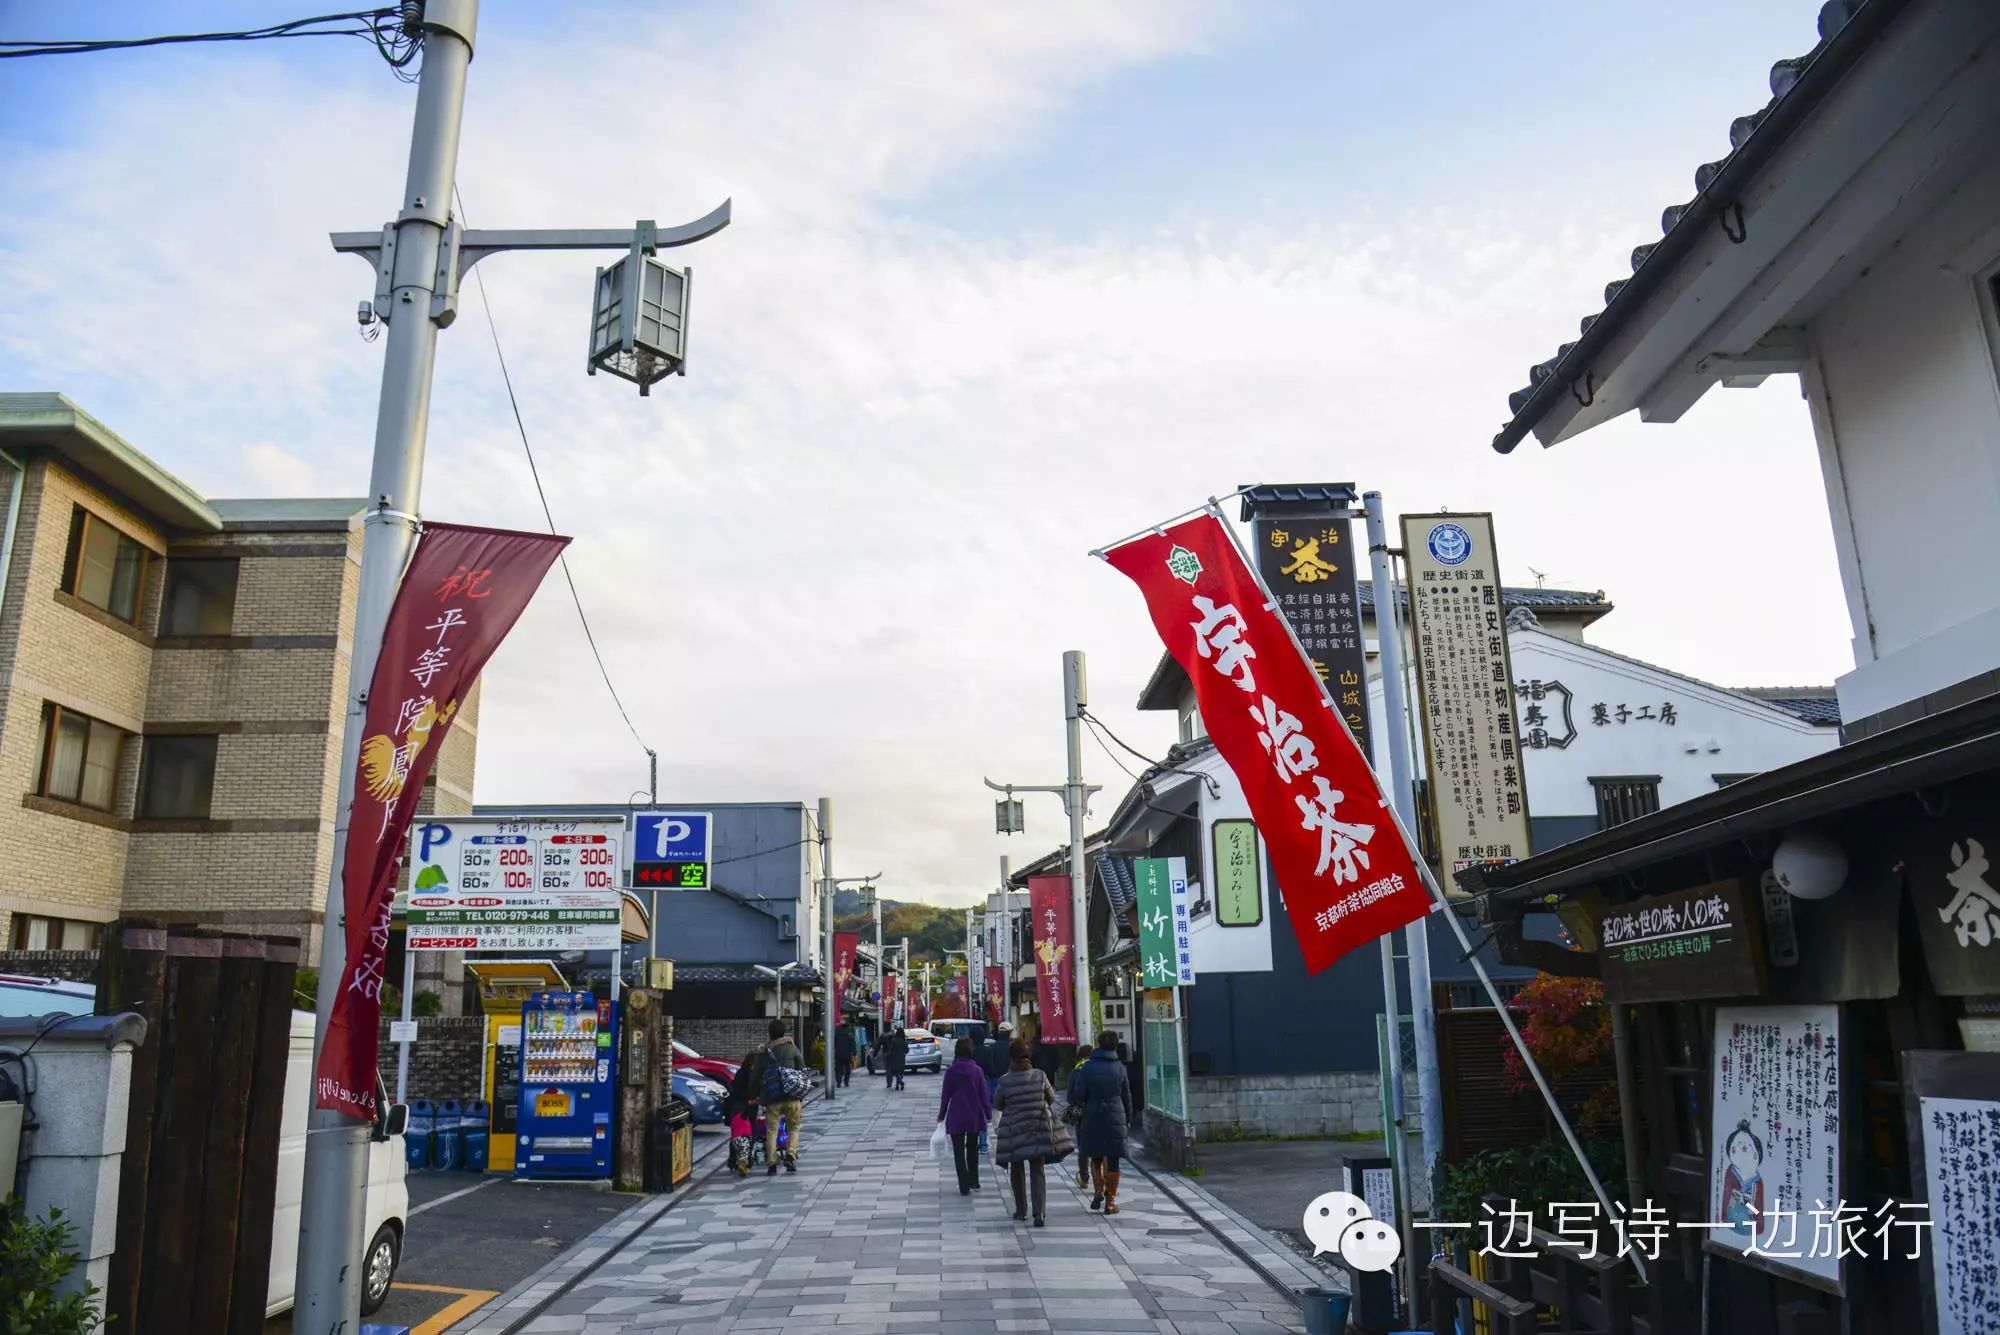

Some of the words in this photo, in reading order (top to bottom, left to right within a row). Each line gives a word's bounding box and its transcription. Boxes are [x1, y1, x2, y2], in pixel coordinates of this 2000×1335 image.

[1280, 536, 1338, 583] 茶
[433, 564, 494, 603] 祝
[1423, 569, 1486, 581] 歴史街道
[1416, 587, 1448, 776] 私たちも、歴史街道を応援しています。
[1482, 585, 1521, 815] 歴史街道物産倶楽部
[1591, 702, 1678, 727] 菓子工房
[1191, 594, 1375, 886] 宇治茶
[497, 820, 577, 832] 宇治川パーキング
[418, 822, 452, 862] P
[652, 818, 691, 858] P
[464, 855, 490, 866] 30分
[500, 849, 533, 866] 200円
[544, 854, 570, 866] 30分
[580, 848, 613, 865] 300円
[1458, 844, 1512, 859] 歴史街道
[462, 877, 489, 889] 60分
[504, 871, 532, 888] 100円
[542, 876, 570, 888] 60分
[584, 871, 612, 888] 100円
[681, 863, 704, 886] 空
[1173, 881, 1184, 893] P
[1938, 837, 2000, 948] 茶
[1314, 873, 1405, 932] 京都府茶協同組合
[466, 911, 484, 920] TEL
[484, 910, 549, 920] 0120-979-446
[558, 910, 615, 919] 駐車場用地募集
[412, 938, 476, 947] サービスコイン
[479, 937, 559, 947] をお渡し致します。
[1142, 906, 1177, 983] 竹林
[1175, 904, 1192, 981] 専用駐車場
[632, 1030, 643, 1045] P
[542, 1100, 564, 1108] BOSS
